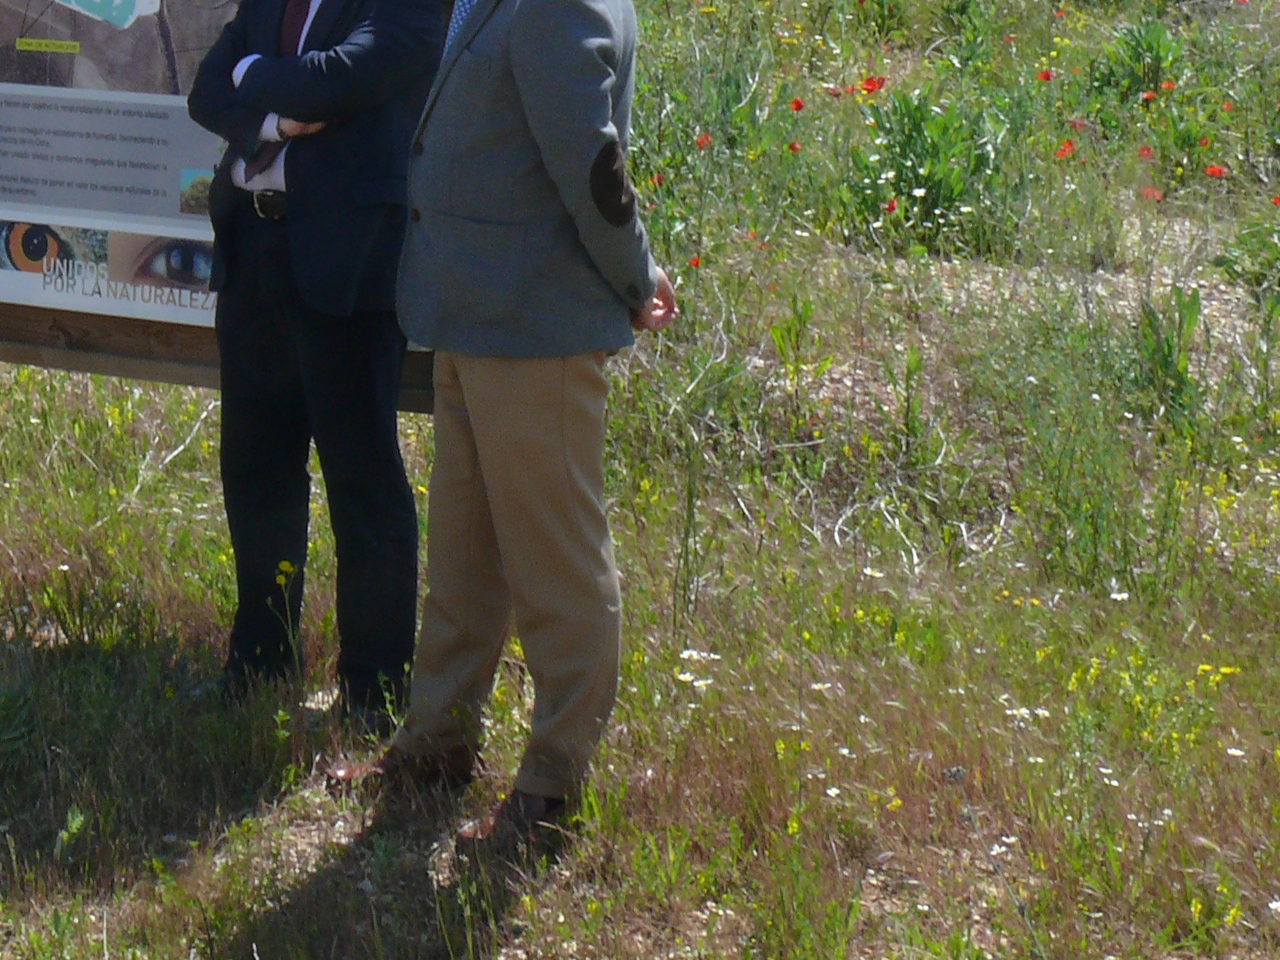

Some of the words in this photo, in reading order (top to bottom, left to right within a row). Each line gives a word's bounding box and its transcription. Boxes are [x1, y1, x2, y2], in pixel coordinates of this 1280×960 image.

[42, 257, 108, 281] UNIDOS
[42, 273, 77, 294] POR
[81, 277, 103, 298] LA
